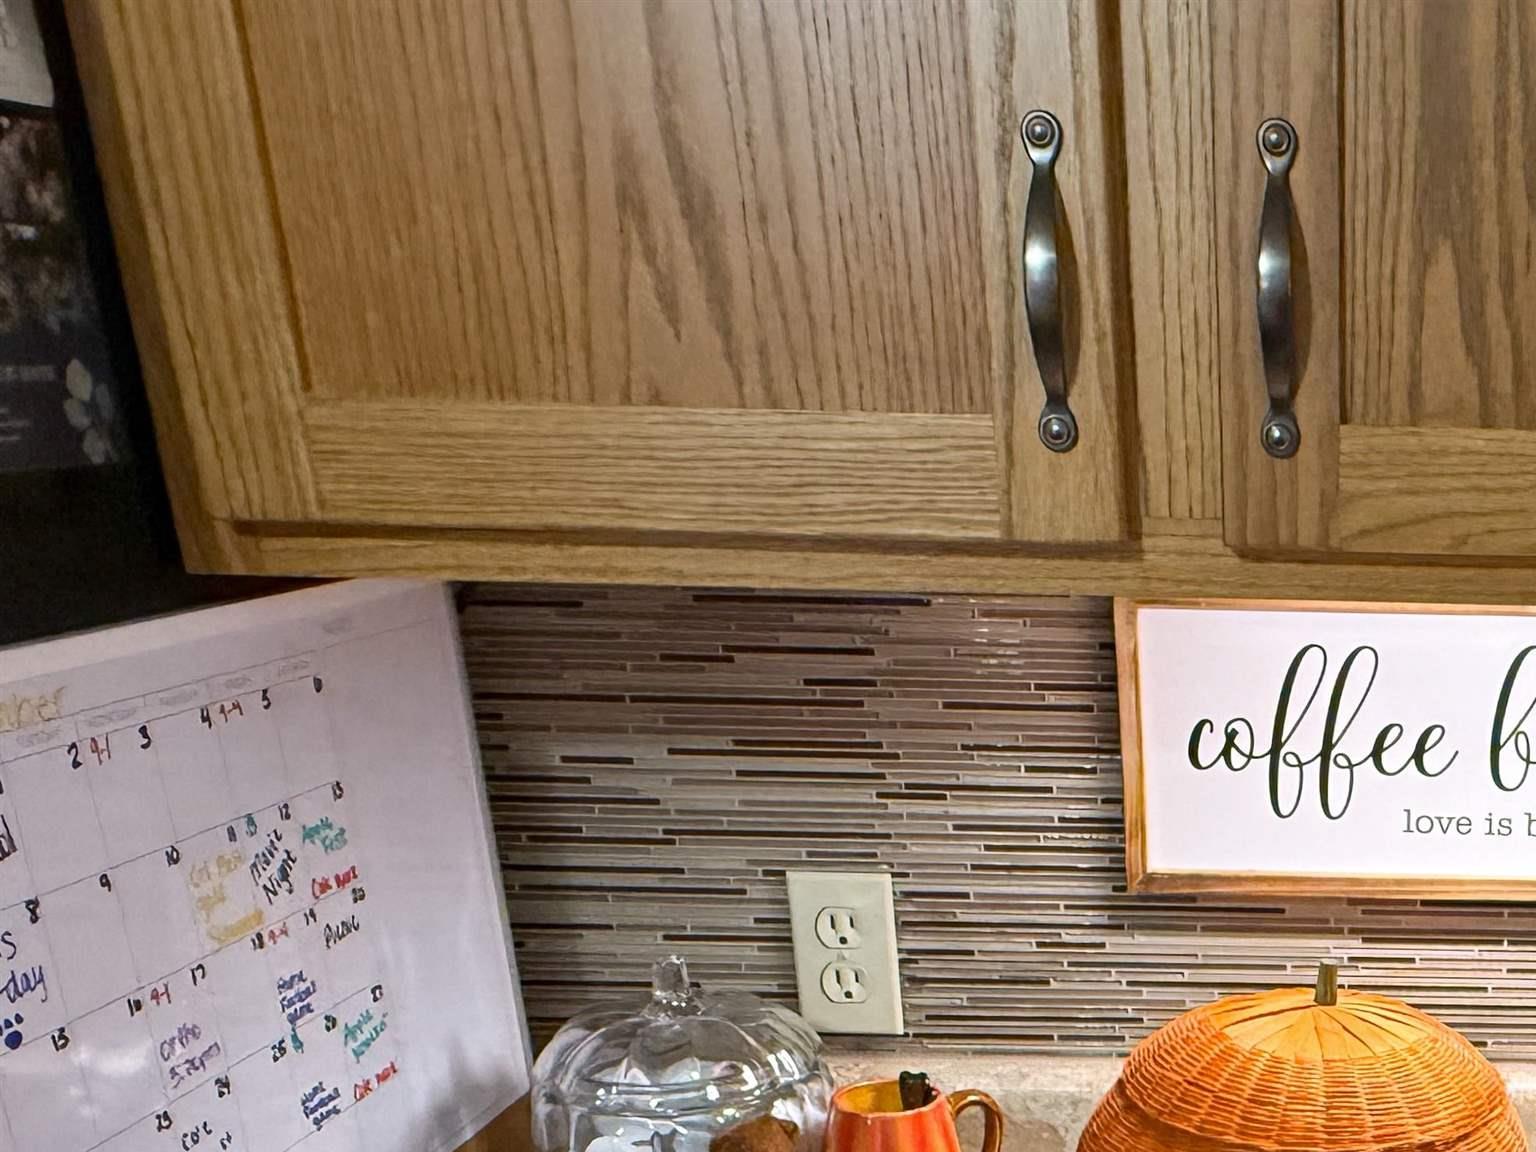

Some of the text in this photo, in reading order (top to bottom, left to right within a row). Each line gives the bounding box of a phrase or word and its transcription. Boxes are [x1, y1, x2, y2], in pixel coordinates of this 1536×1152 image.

[200, 705, 213, 729] 4
[138, 725, 152, 750] 3
[1187, 643, 1459, 820] coffee
[67, 742, 83, 769] 2
[1402, 809, 1473, 837] love
[1484, 812, 1513, 838] is
[99, 873, 112, 892] 9
[24, 895, 41, 924] 8
